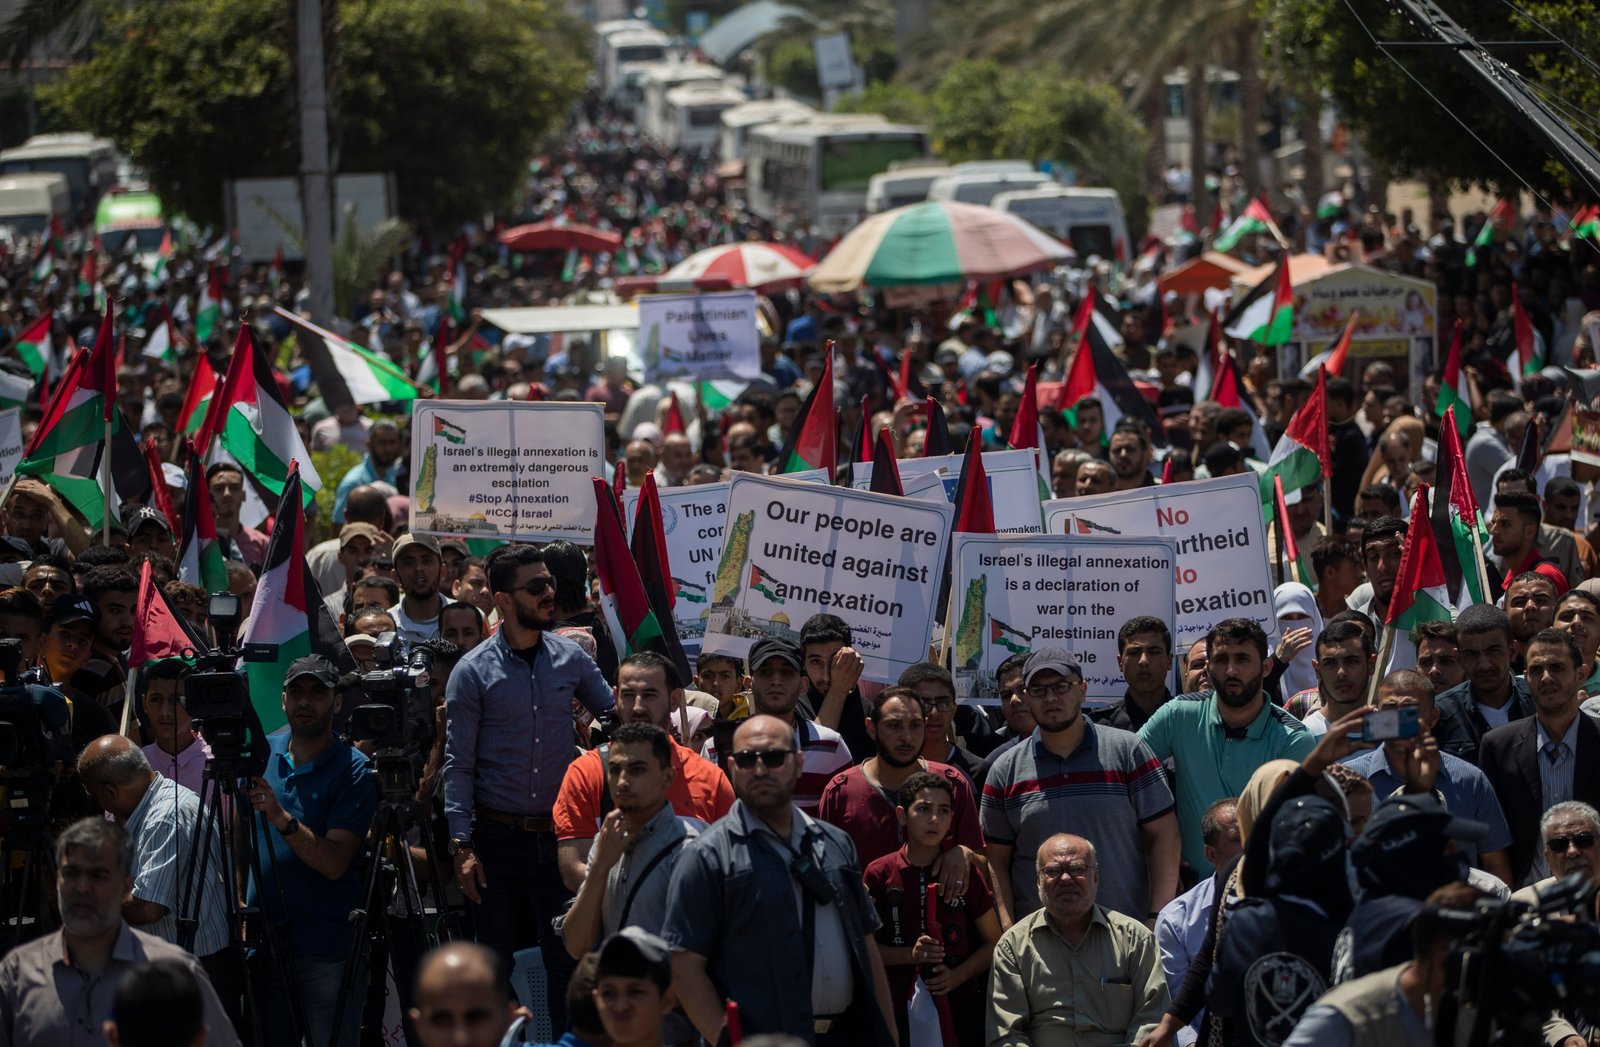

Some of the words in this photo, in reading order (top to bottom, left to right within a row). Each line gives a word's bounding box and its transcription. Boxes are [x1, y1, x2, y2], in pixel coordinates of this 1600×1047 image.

[444, 446, 483, 457] Israel's
[487, 446, 520, 460] illegal
[523, 447, 585, 458] annexation
[589, 447, 598, 458] is
[453, 464, 466, 472] an
[470, 463, 525, 476] extremely
[528, 463, 588, 475] dangerous
[492, 477, 549, 489] escalation
[469, 493, 501, 506] #Stop
[505, 493, 569, 505] Annexation
[485, 508, 518, 518] #ICC4
[522, 508, 552, 519] Israel
[681, 503, 712, 517] The
[1156, 506, 1190, 528] No
[767, 501, 810, 524] Our
[815, 512, 894, 545] people
[900, 527, 937, 546] are
[689, 547, 713, 563] UN
[980, 553, 1032, 566] Israel's
[1037, 553, 1081, 569] illegal
[1086, 555, 1169, 569] annexation
[764, 541, 837, 568] united
[842, 554, 929, 584] against
[1006, 577, 1018, 591] is
[1022, 581, 1031, 591] a
[1035, 578, 1119, 592] declaration
[1124, 579, 1139, 592] of
[775, 581, 904, 618] annexation
[1037, 604, 1064, 616] war
[1068, 605, 1086, 615] on
[1091, 603, 1115, 616] the
[1032, 626, 1115, 639] Palestinian
